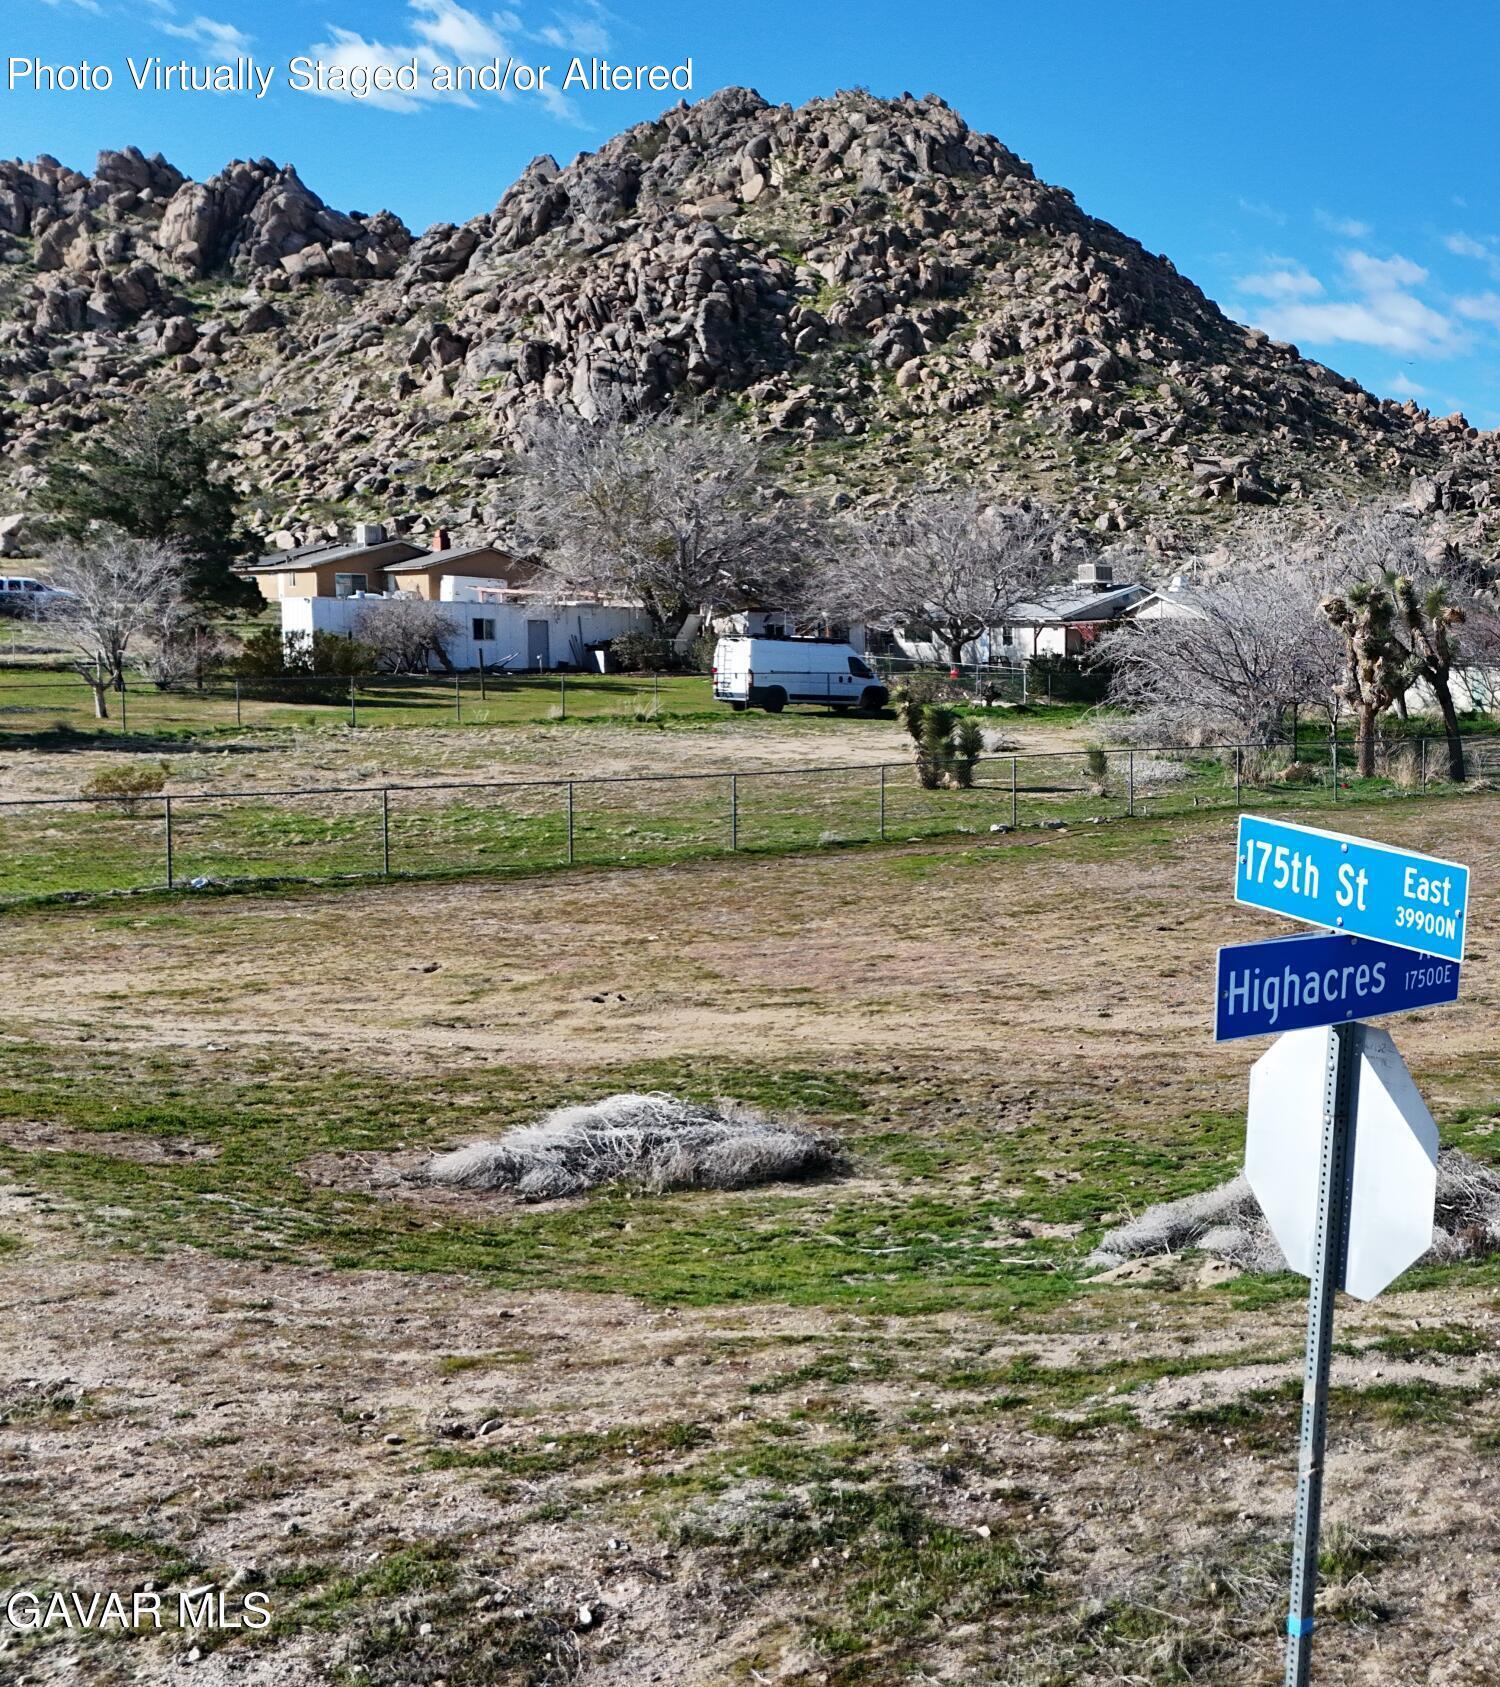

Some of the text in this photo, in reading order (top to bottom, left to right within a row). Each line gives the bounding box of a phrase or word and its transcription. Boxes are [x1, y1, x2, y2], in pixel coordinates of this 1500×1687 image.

[1246, 839, 1369, 911] 175th St
[1403, 867, 1452, 907] East
[1395, 906, 1456, 940] 39900N
[1228, 961, 1386, 1024] Highacres
[1405, 965, 1452, 991] 17500E
